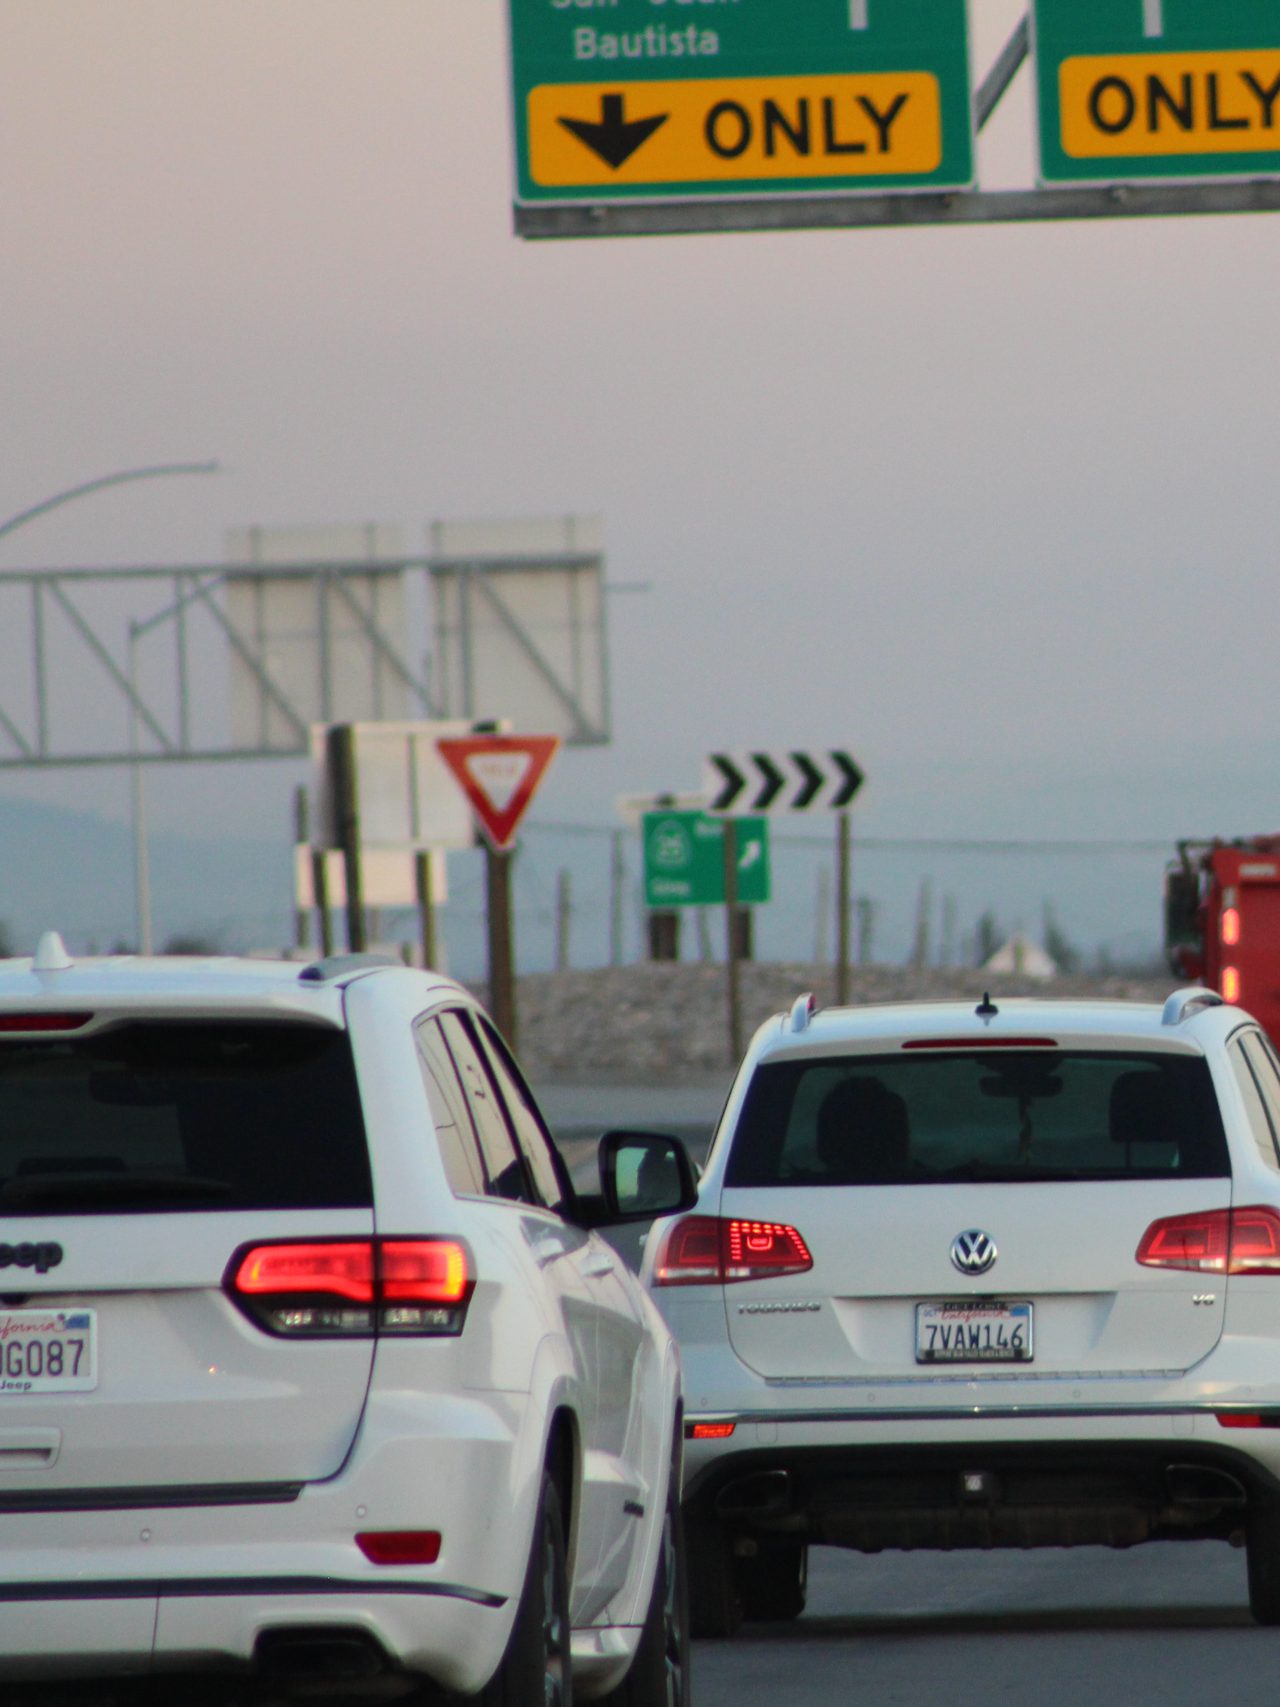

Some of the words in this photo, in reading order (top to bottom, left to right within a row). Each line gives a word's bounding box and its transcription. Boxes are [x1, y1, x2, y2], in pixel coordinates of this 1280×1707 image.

[574, 24, 720, 59] Bautista
[704, 93, 910, 160] ONLY
[925, 1324, 1023, 1351] 7VAW146
[0, 1339, 84, 1377] G087
